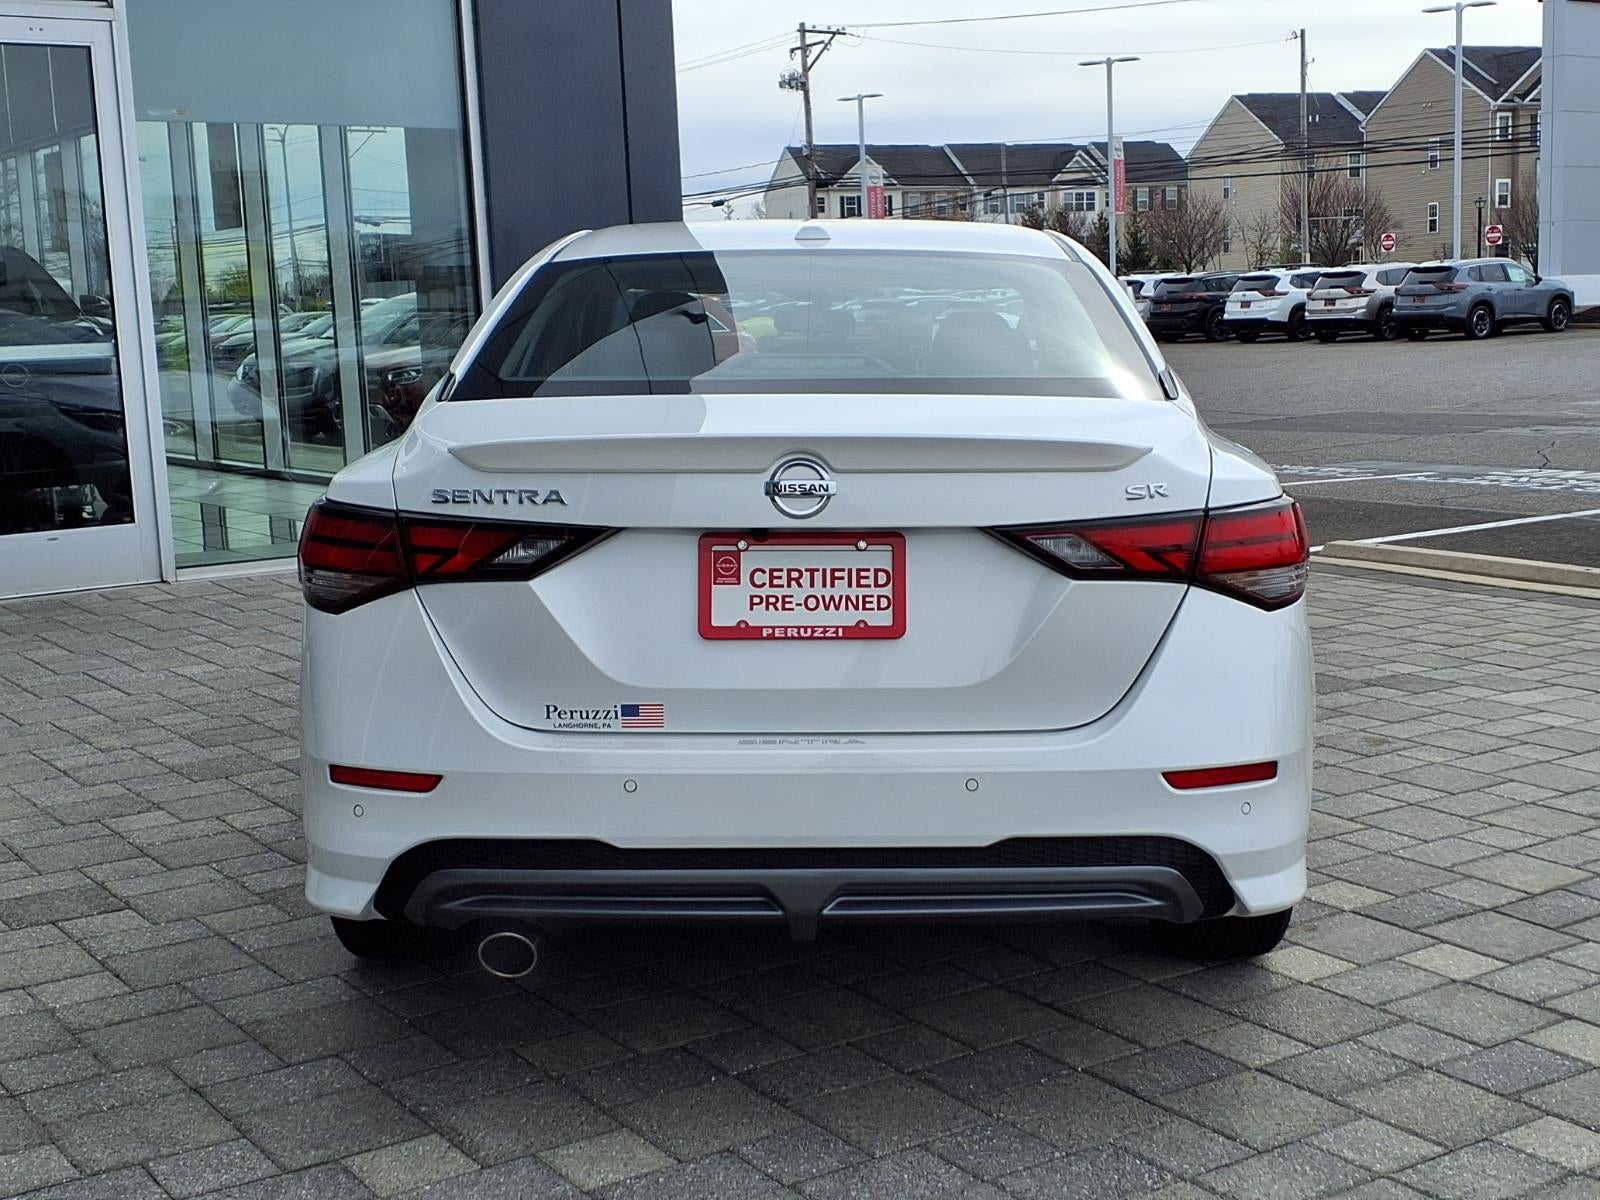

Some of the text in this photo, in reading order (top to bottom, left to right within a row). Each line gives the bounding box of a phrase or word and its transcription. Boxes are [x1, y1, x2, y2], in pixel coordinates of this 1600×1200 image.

[772, 483, 829, 493] NISSAN
[1125, 482, 1169, 501] SR
[431, 488, 568, 505] SENTRA
[749, 567, 892, 589] CERTIFIED
[749, 594, 892, 612] PRE-OWNED
[762, 627, 843, 637] PERUZZI
[544, 704, 619, 720] Peruzzi
[553, 722, 601, 730] LANGHORNE,
[737, 737, 866, 745] SENTRA
